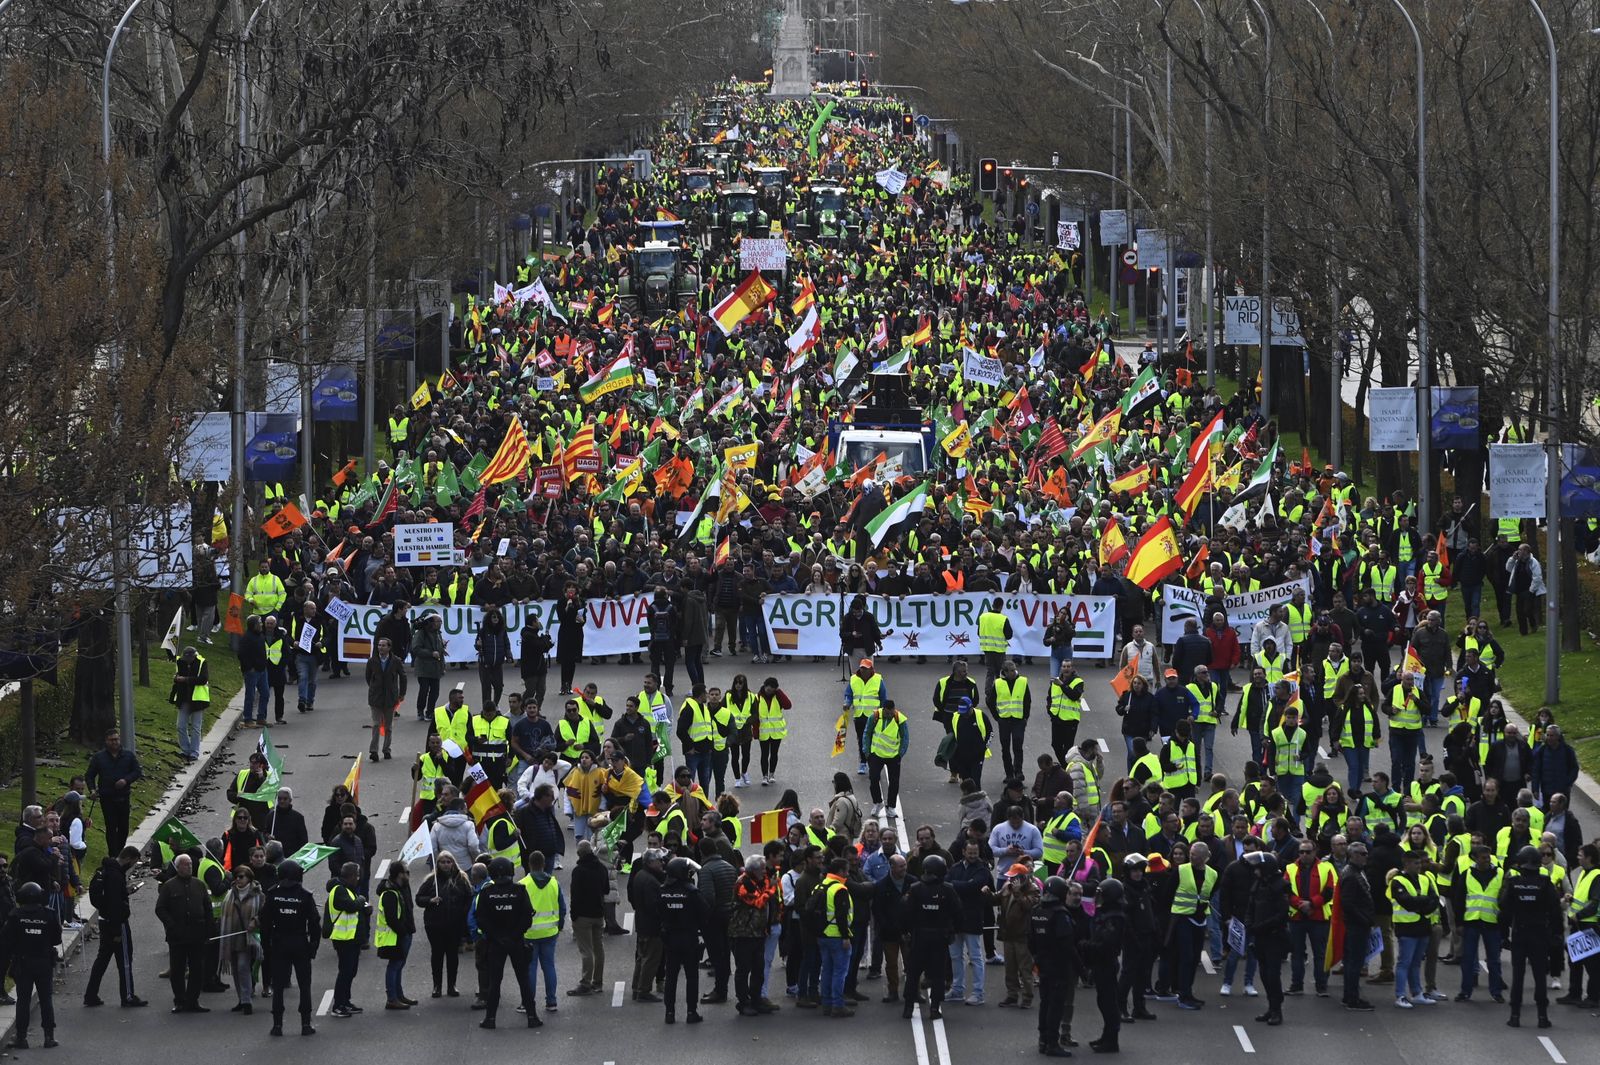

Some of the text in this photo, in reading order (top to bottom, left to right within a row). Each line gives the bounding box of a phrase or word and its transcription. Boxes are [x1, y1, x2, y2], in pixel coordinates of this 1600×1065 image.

[1226, 299, 1260, 312] MAD
[1238, 311, 1260, 324] RID
[578, 459, 598, 467] UAGN
[1492, 476, 1543, 485] QUINTANILLA
[404, 527, 432, 535] NUESTRO
[425, 543, 451, 551] HAMBRE
[1226, 596, 1247, 609] DEL
[1001, 832, 1026, 842] TOMMY
